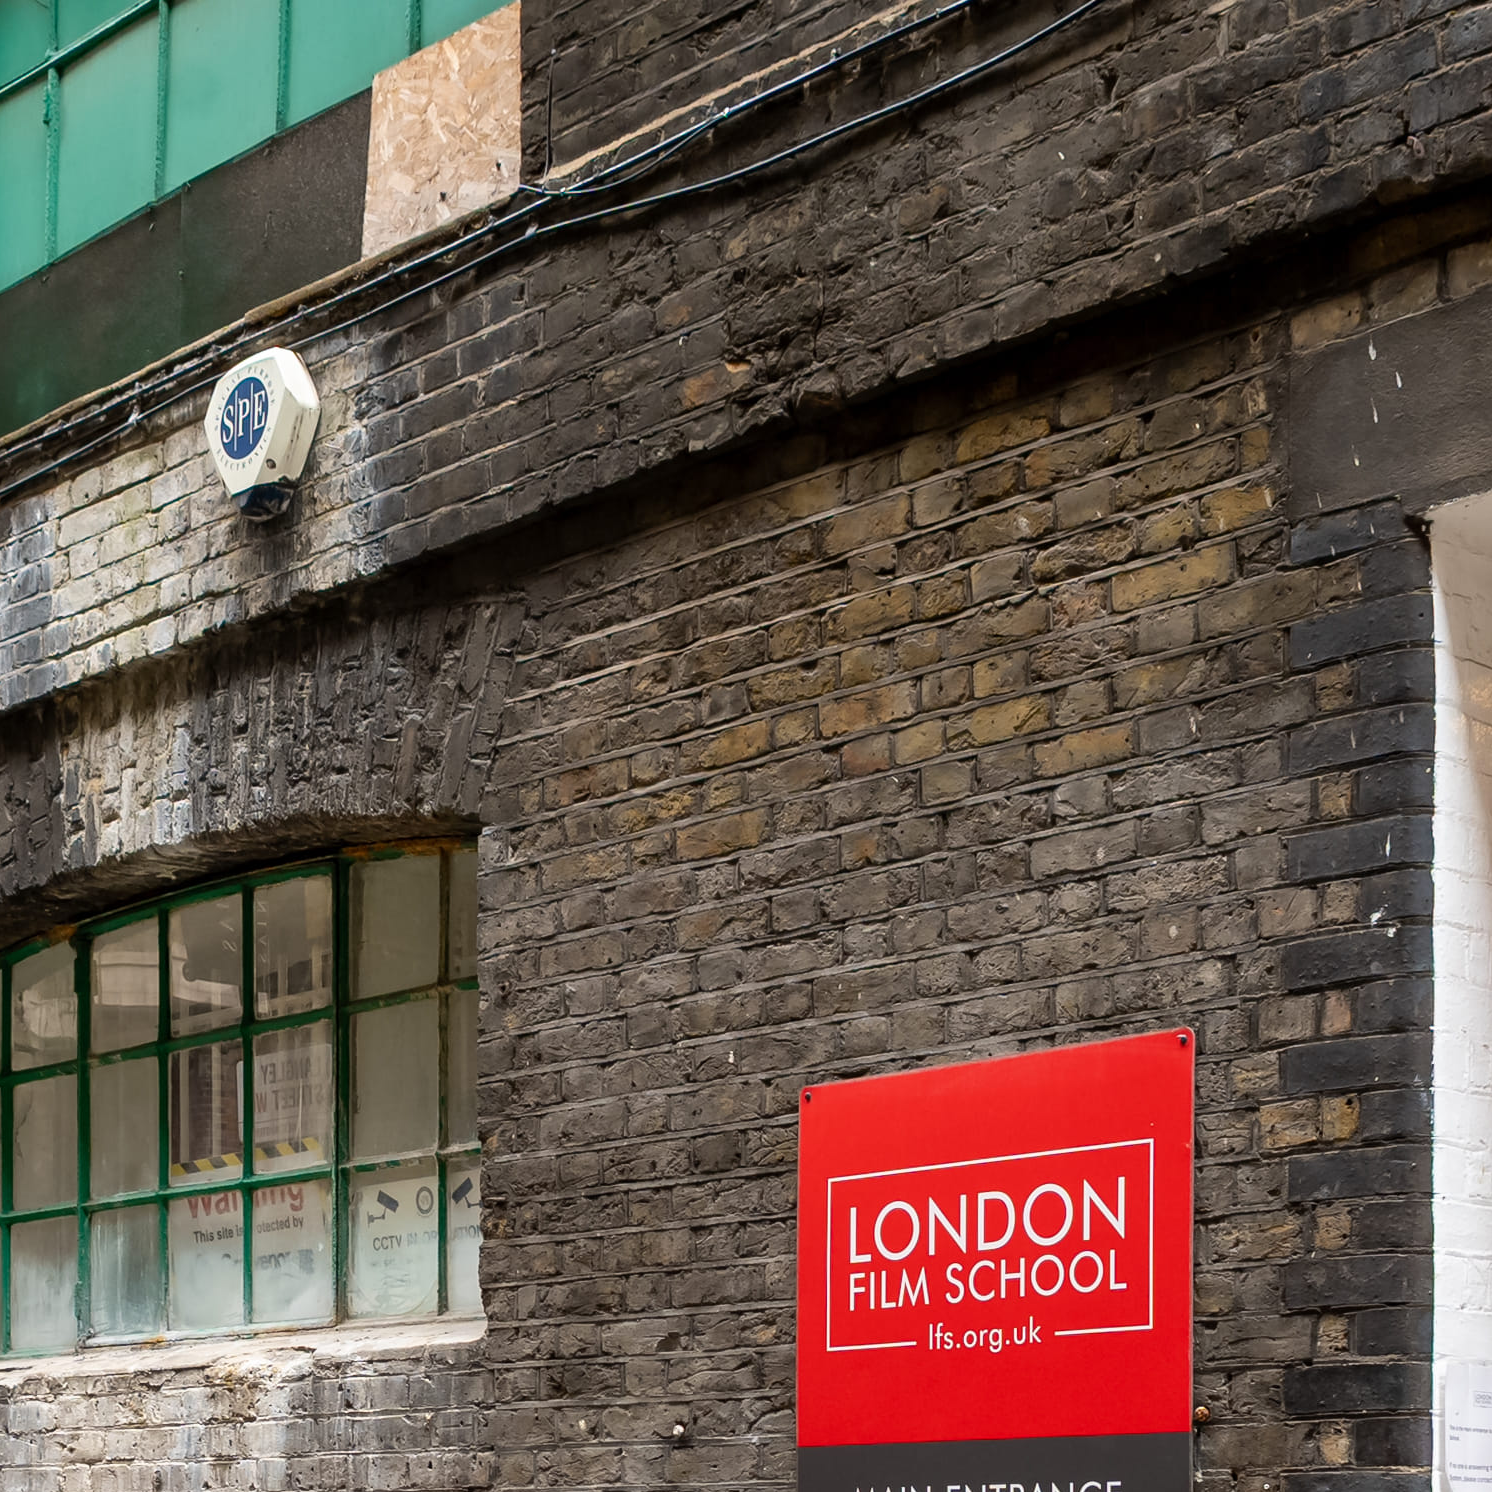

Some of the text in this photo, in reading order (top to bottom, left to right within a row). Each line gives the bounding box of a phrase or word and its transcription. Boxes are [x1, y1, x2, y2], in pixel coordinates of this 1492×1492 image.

[193, 1230, 214, 1244] This
[217, 1226, 234, 1240] site
[293, 1216, 304, 1232] by
[849, 1176, 1125, 1264] LONDON
[373, 1234, 401, 1251] CCTV
[849, 1249, 1127, 1311] FILM SCHOOL
[929, 1316, 1041, 1353] lfs.org.uk
